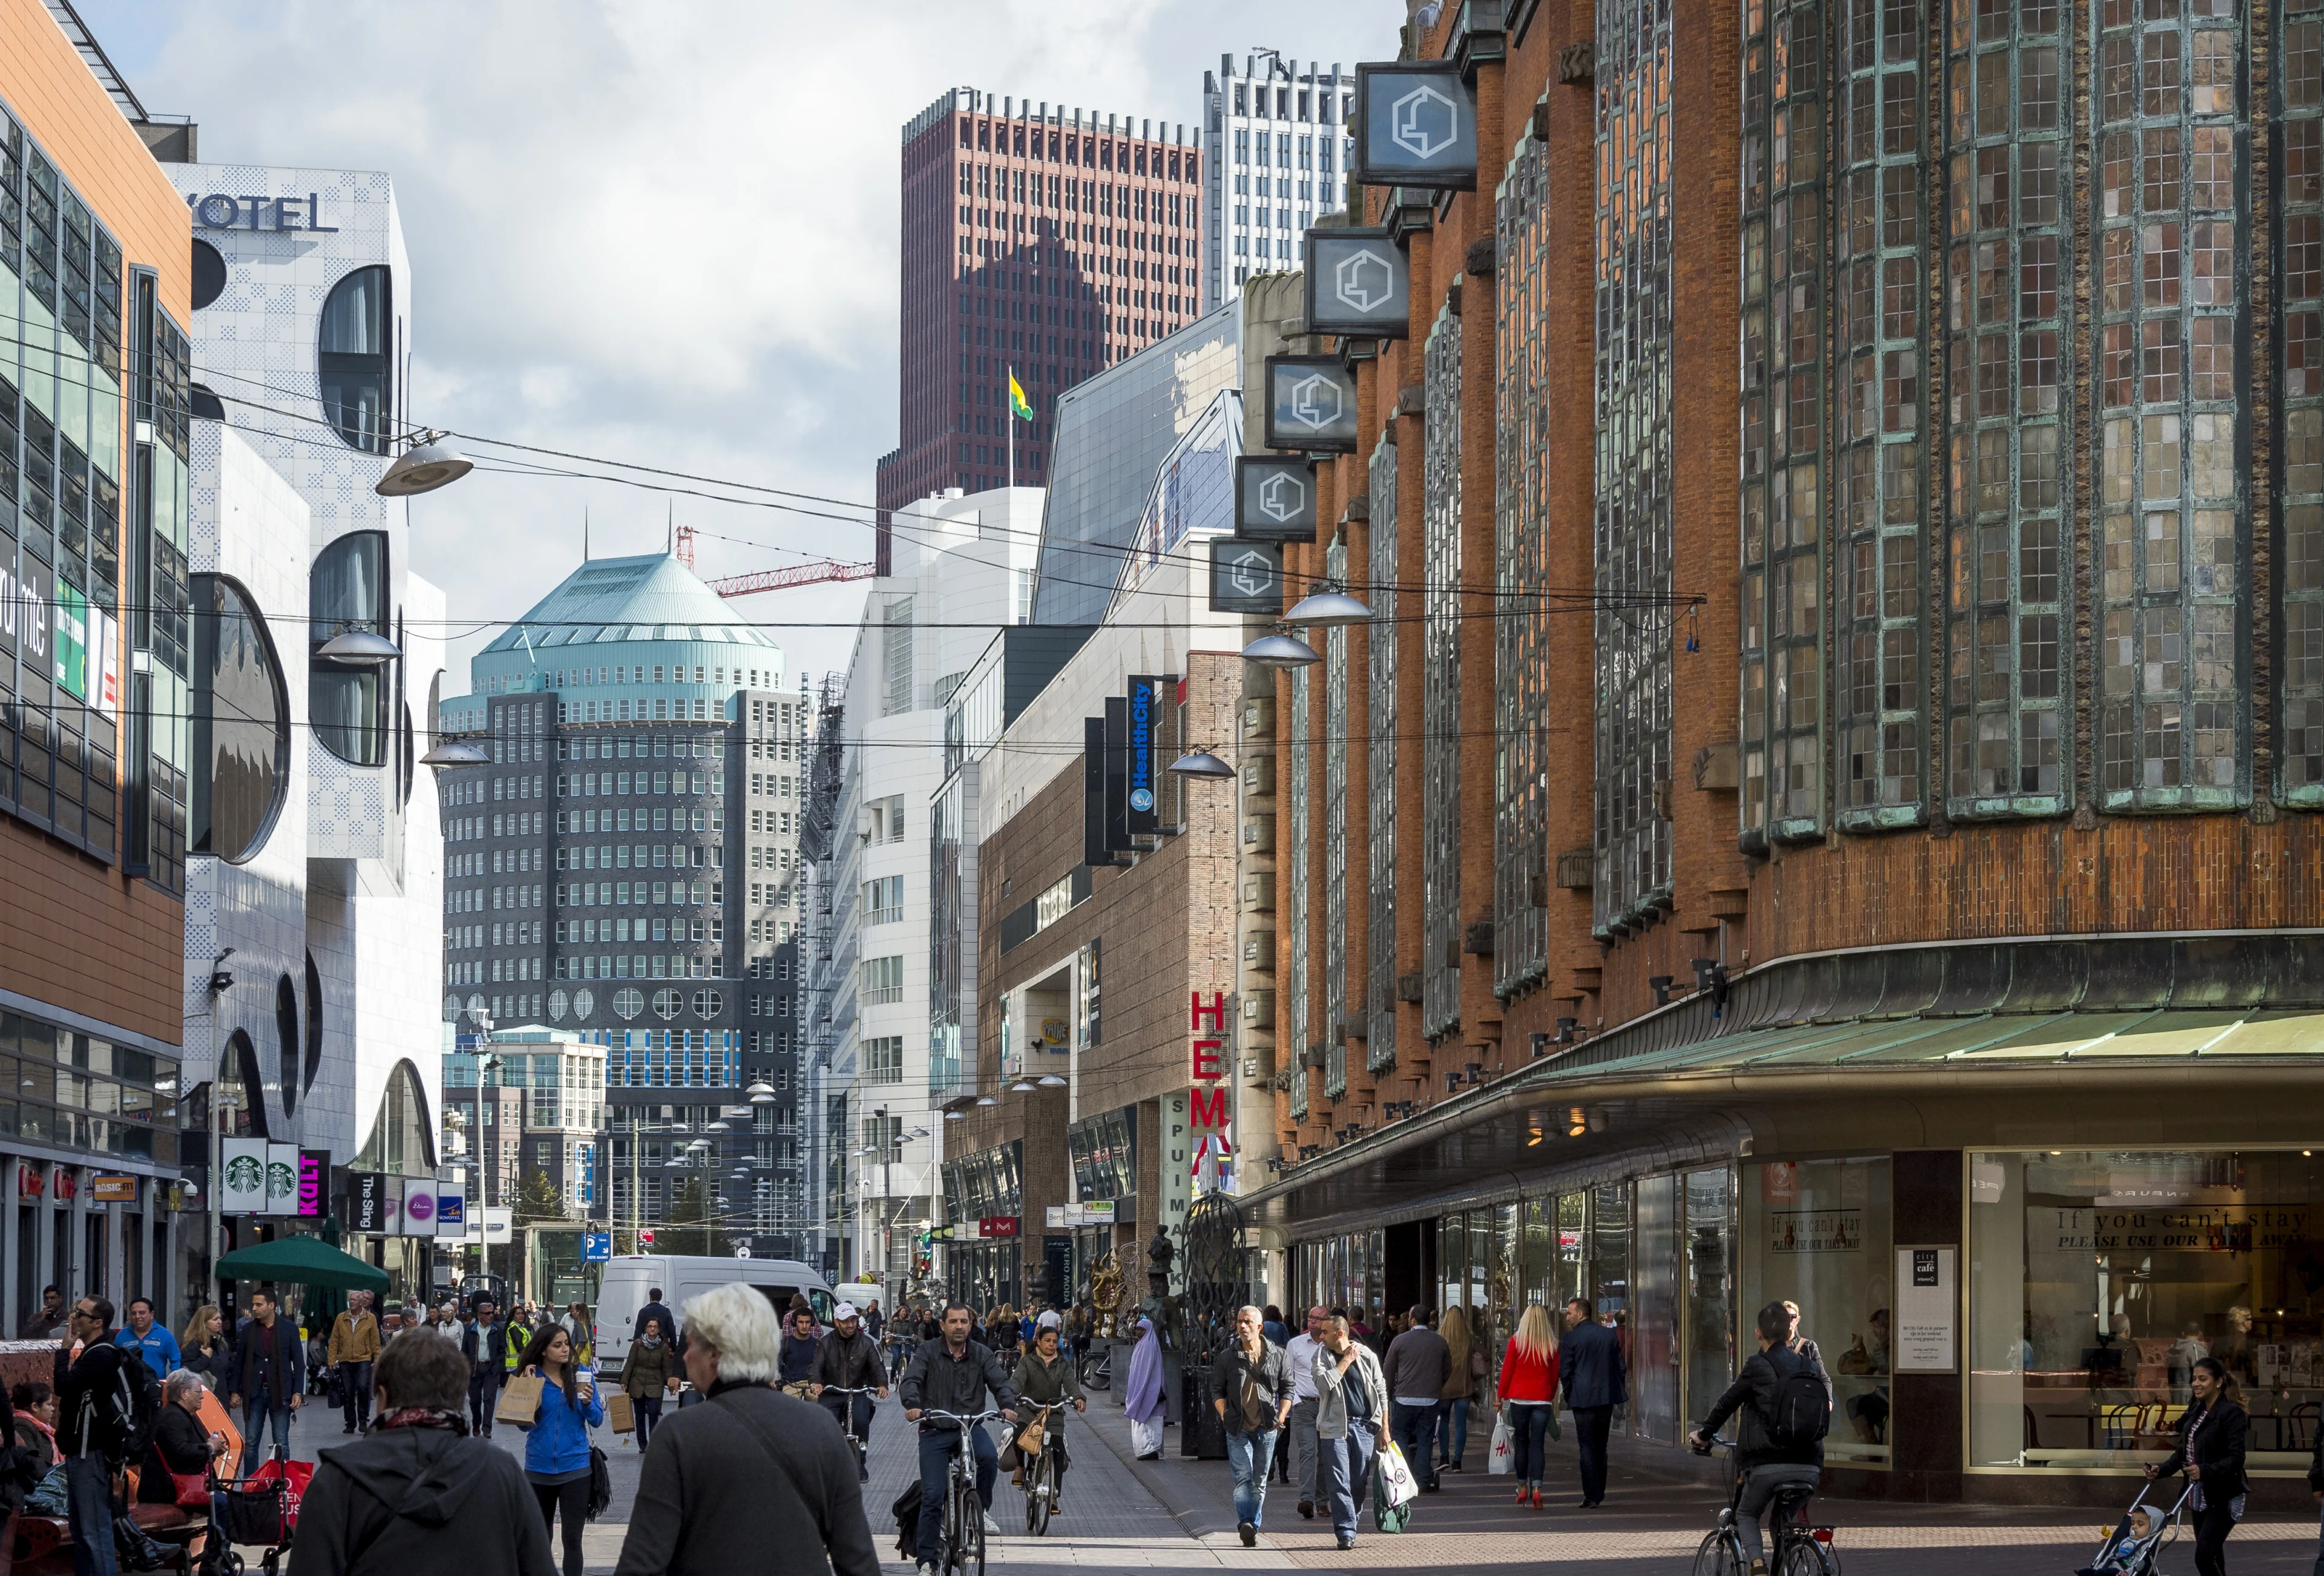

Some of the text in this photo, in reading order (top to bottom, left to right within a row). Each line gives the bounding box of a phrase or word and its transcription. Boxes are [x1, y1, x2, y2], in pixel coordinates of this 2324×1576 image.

[187, 193, 339, 232] OTEL
[1133, 683, 1151, 787] HealthCity
[300, 1155, 318, 1215] KULT
[360, 1177, 373, 1228] The Sting
[1772, 1215, 1782, 1233] If
[1809, 1215, 1834, 1233] can't
[2058, 1209, 2307, 1233] If you can't stay
[1796, 1240, 1807, 1250] USE
[1809, 1240, 1822, 1250] OUR
[2058, 1235, 2306, 1247] PLEASE USE OUR TAKE AWAY
[1917, 1253, 1934, 1261] city
[1917, 1262, 1934, 1272] café
